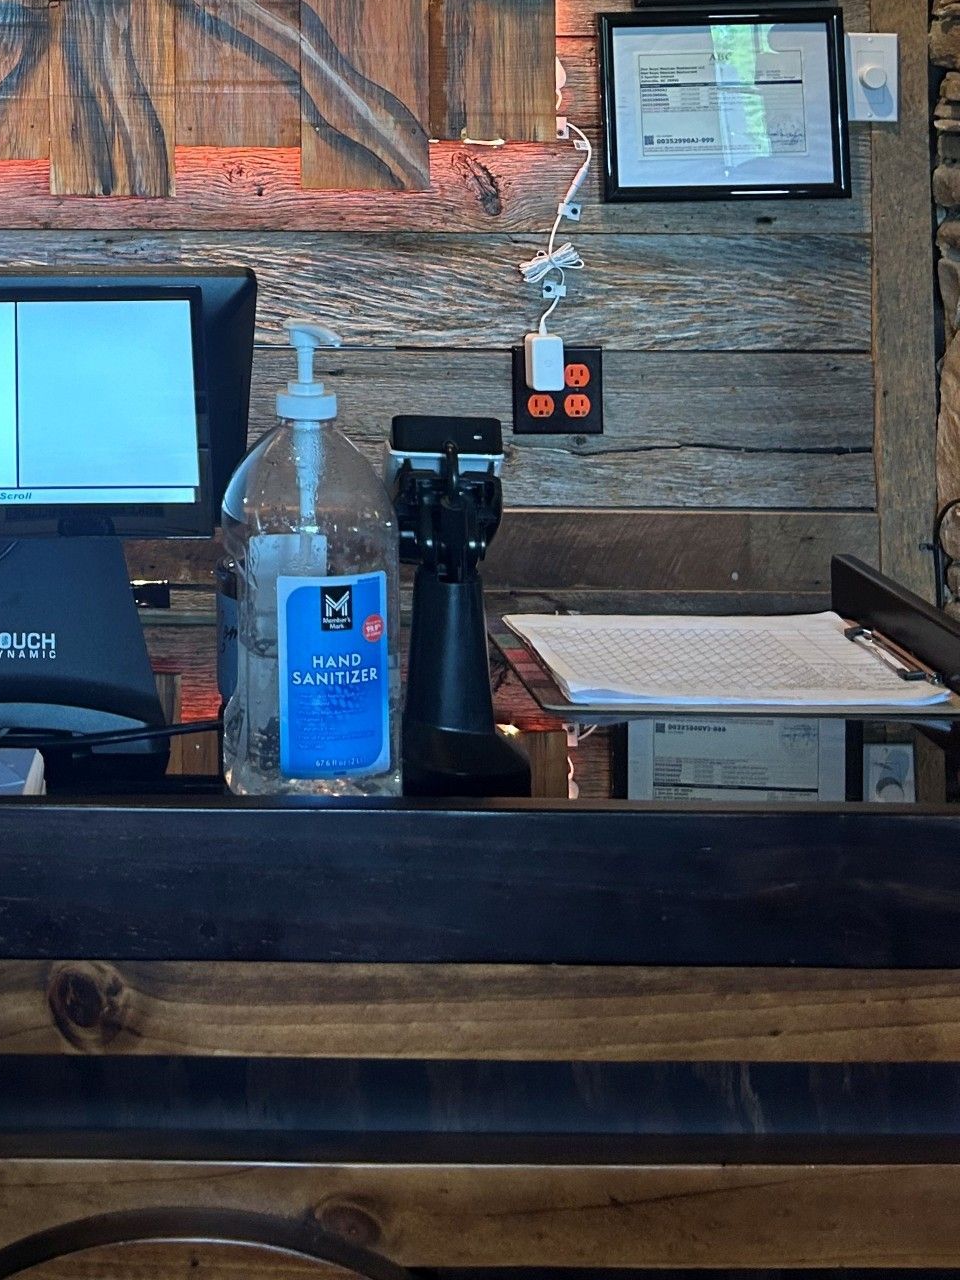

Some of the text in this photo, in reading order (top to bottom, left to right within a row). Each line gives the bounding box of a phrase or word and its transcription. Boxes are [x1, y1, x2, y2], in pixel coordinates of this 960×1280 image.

[0, 491, 32, 501] Scroll
[312, 653, 361, 668] HAND
[292, 668, 378, 685] SANITIZER
